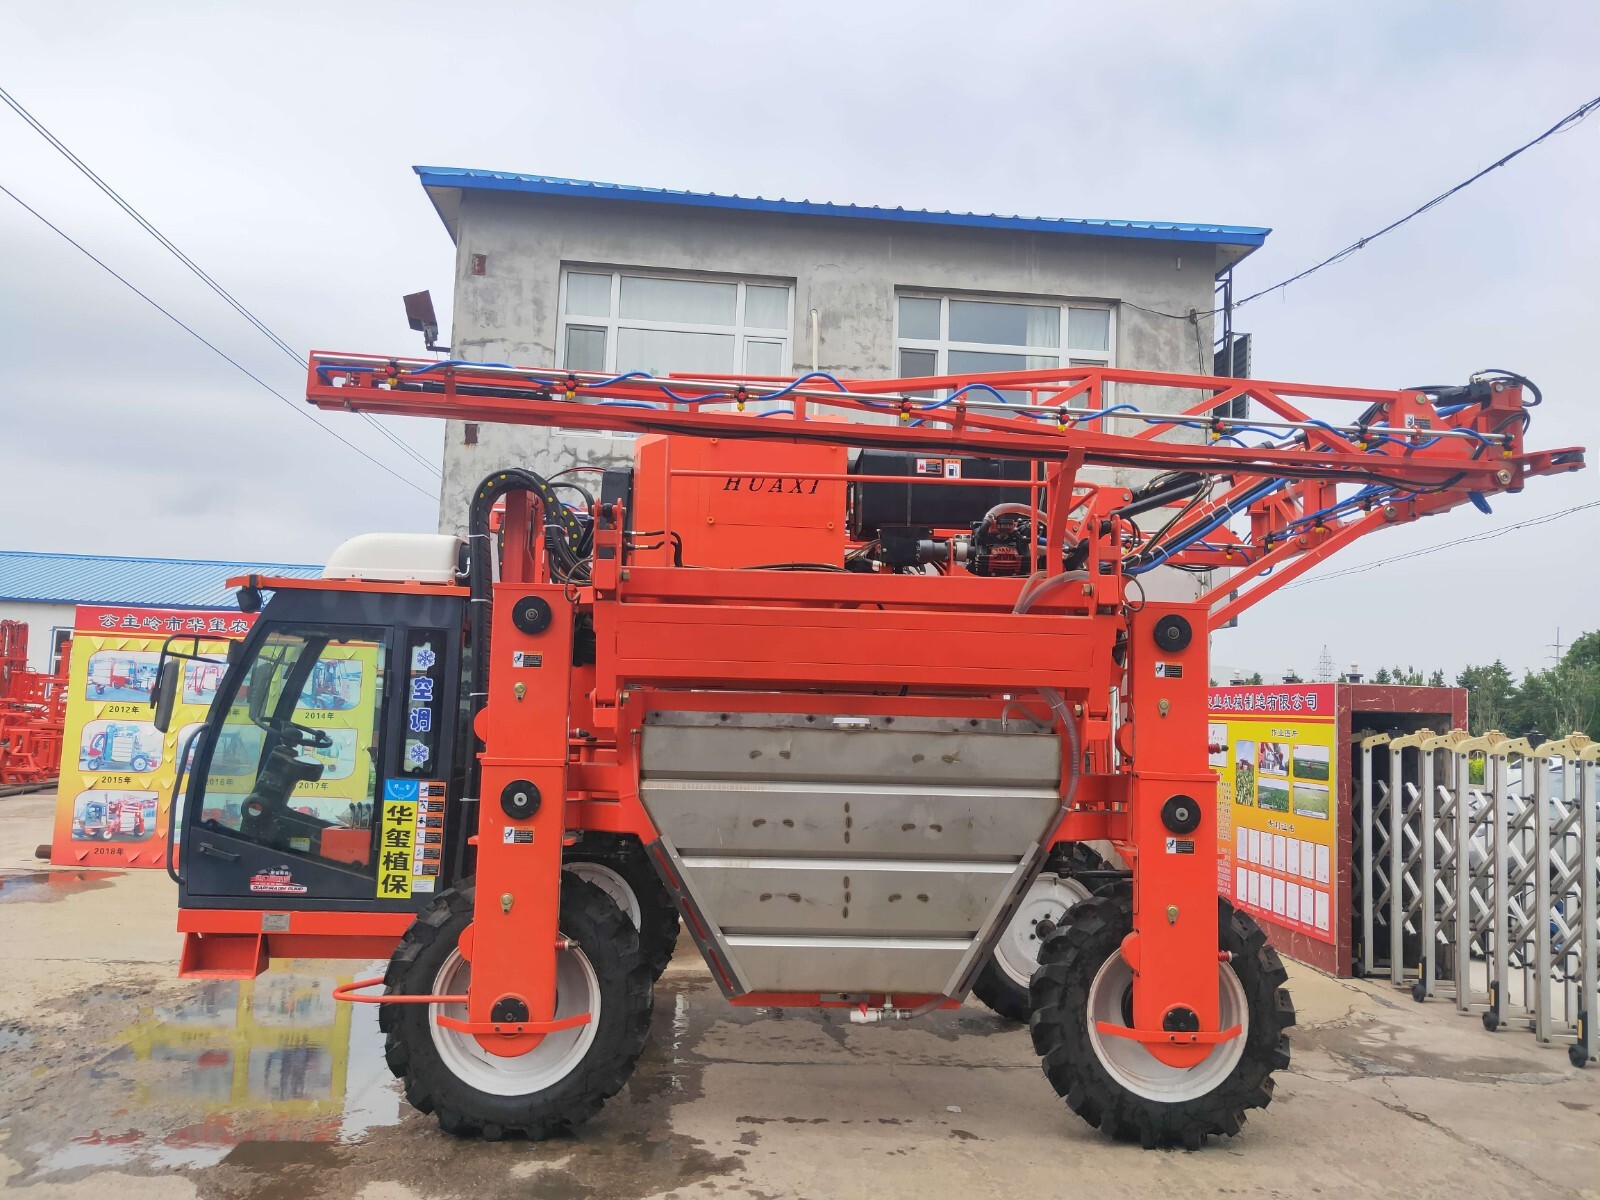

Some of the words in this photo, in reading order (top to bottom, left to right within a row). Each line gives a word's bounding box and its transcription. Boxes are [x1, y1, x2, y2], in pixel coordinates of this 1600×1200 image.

[723, 476, 819, 494] HUAXI
[409, 676, 434, 732] 空调
[108, 705, 140, 714] 2012年
[304, 712, 335, 721] 2014年
[101, 776, 132, 785] 2015年
[298, 782, 329, 791] 2017年
[94, 847, 125, 856] 2018年
[381, 805, 413, 894] 华玺植保
